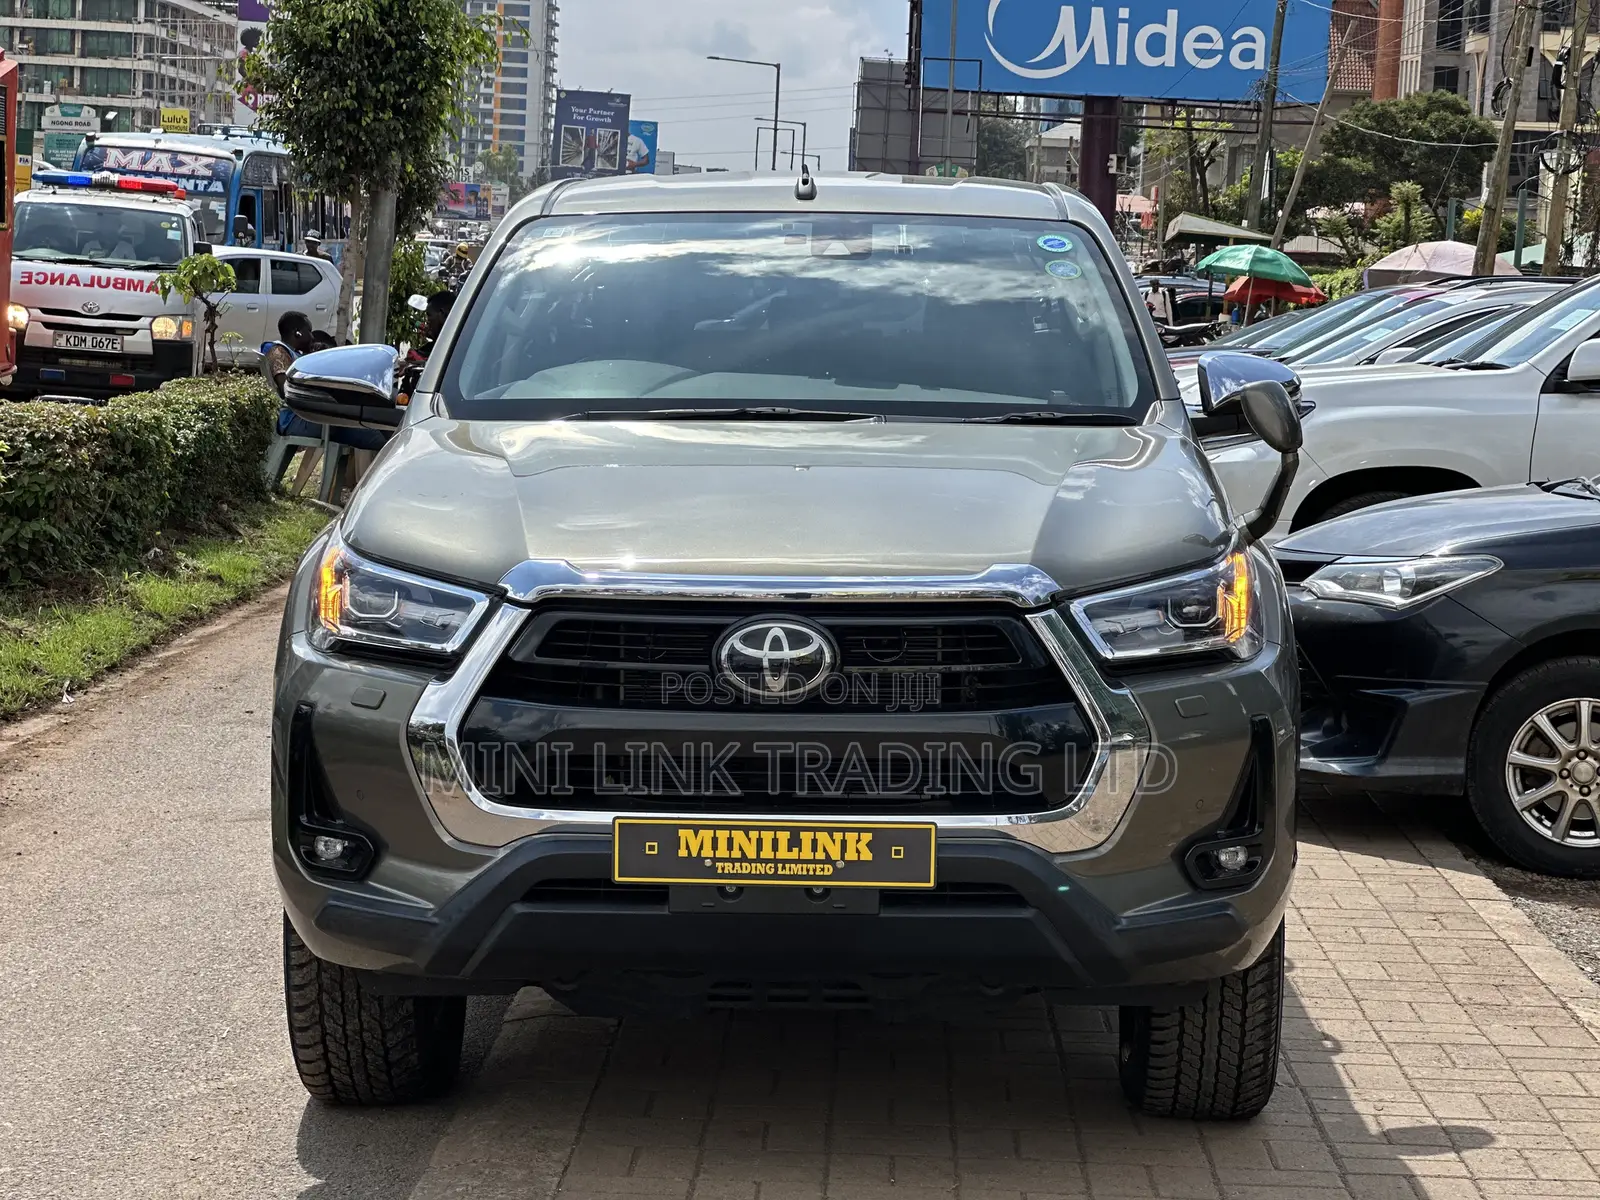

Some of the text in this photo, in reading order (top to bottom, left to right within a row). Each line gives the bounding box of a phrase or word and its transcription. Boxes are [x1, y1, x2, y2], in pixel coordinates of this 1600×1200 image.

[1025, 5, 1267, 71] Midea
[571, 105, 615, 116] Your Partner
[572, 113, 612, 123] For Growth
[162, 114, 188, 124] Lulu's
[103, 148, 215, 176] MAX
[65, 334, 118, 350] KDM 067E
[677, 828, 873, 861] MINILINK
[716, 862, 833, 876] TRADING LIMITED
